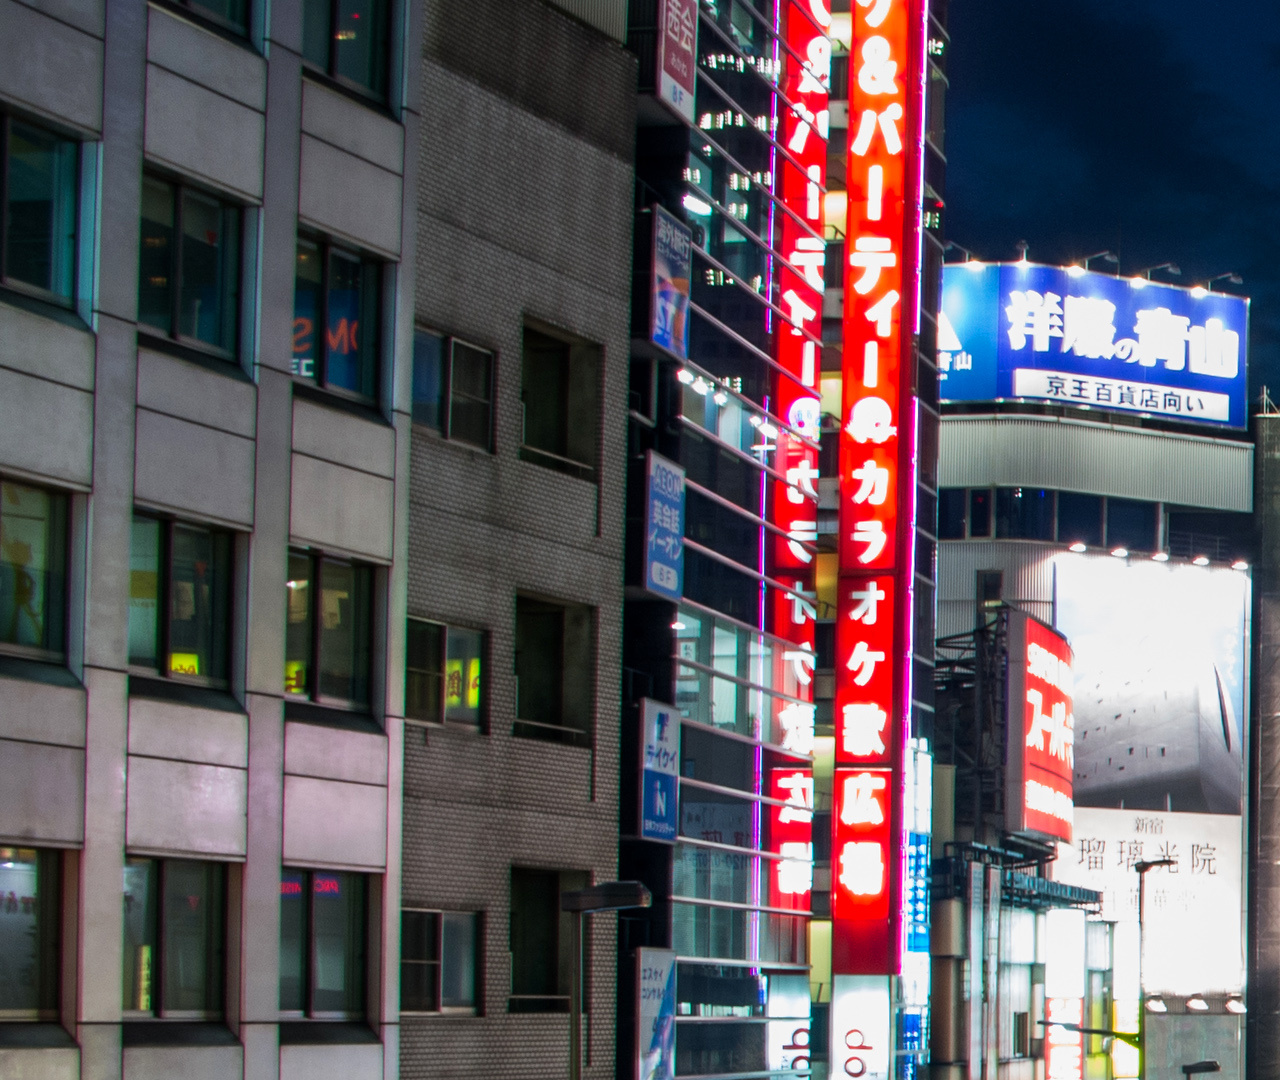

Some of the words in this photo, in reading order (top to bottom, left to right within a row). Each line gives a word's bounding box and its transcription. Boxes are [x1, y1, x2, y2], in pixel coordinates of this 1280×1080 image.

[1005, 289, 1240, 380] 洋服の青山
[1046, 375, 1205, 413] 京王百貨店向い
[654, 463, 682, 496] AEON
[653, 500, 681, 534] 英会話
[650, 529, 682, 561] イーオン
[1135, 817, 1164, 835] 新宿
[1078, 838, 1218, 876] 瑠璃光院
